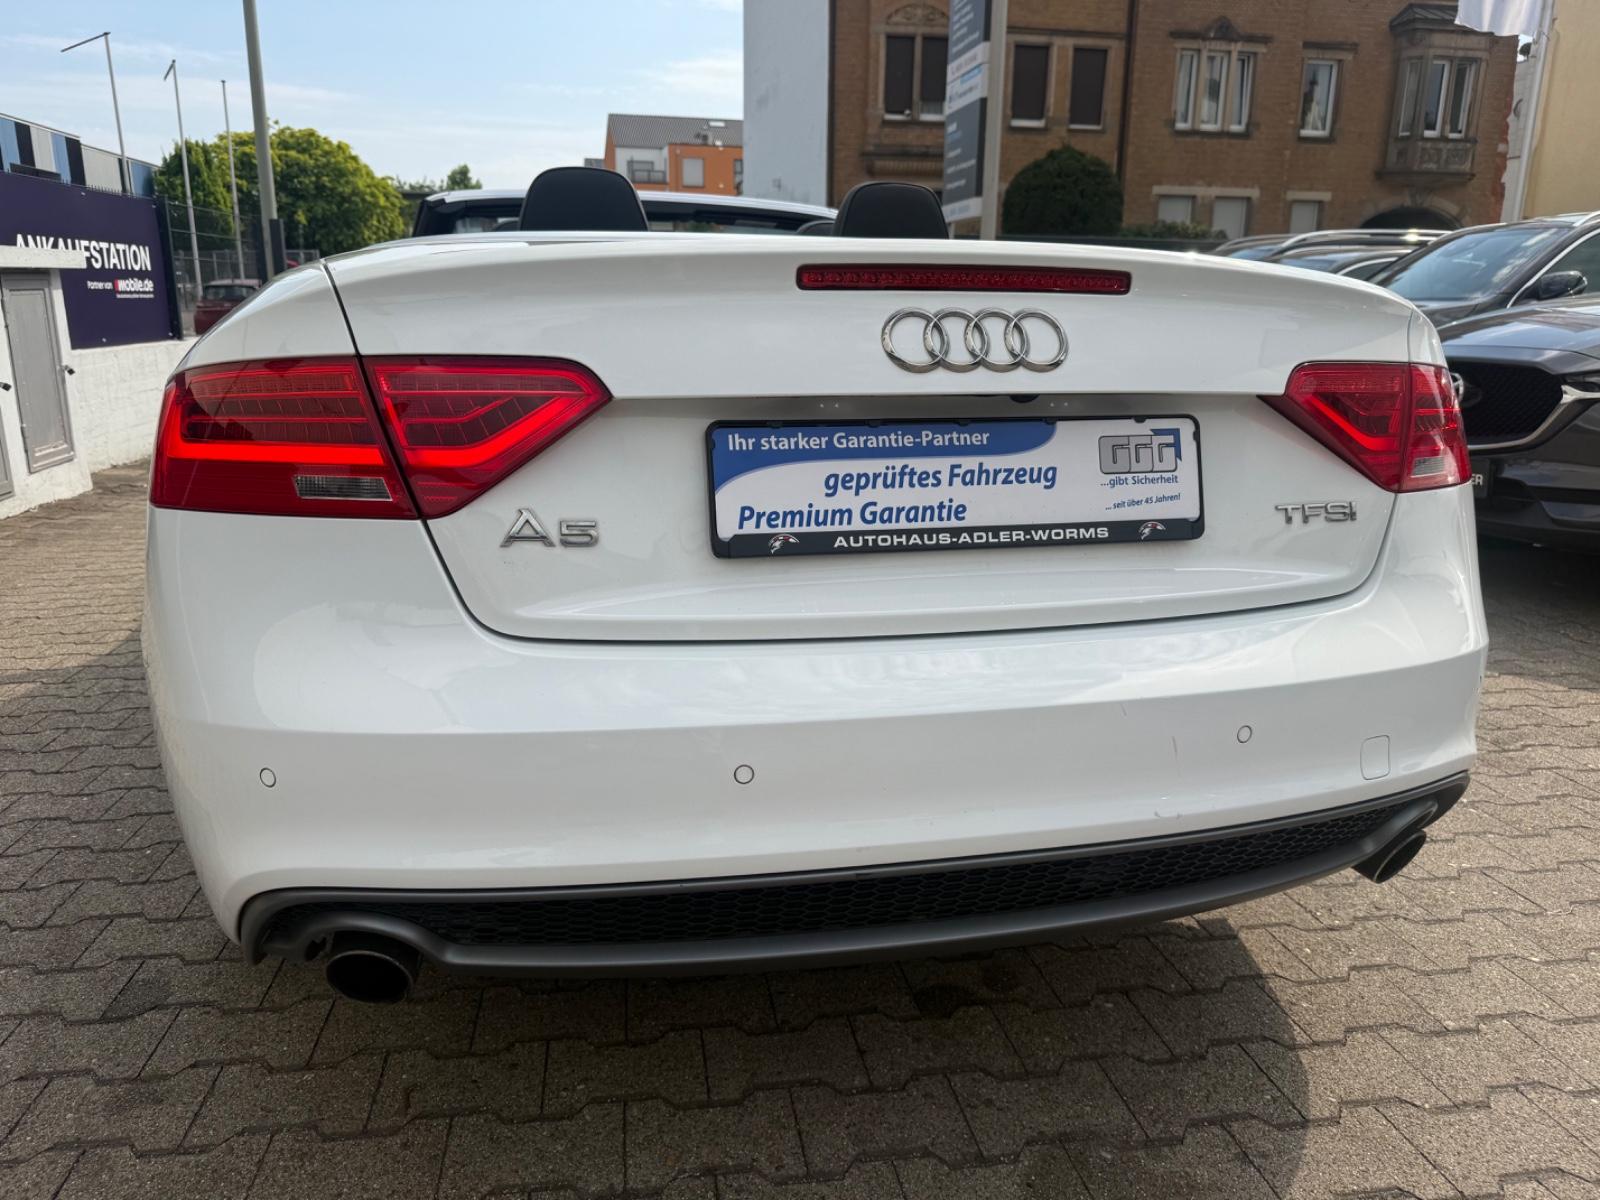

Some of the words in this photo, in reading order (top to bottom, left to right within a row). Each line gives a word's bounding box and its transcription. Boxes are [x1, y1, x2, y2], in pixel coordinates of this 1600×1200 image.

[728, 433, 755, 451] Ihr
[761, 432, 828, 450] starker
[833, 430, 990, 449] Garantie-Partner
[824, 464, 942, 497] geprüftes
[948, 462, 1057, 489] Fahrzeug
[1100, 475, 1129, 488] ...gibt
[1131, 474, 1178, 486] Sicherheit
[1113, 501, 1126, 510] seit
[1126, 497, 1143, 508] über
[1144, 496, 1154, 505] 45
[1154, 492, 1181, 504] Jahren!
[738, 503, 853, 530] Premium
[860, 498, 967, 525] Garantie
[1275, 501, 1357, 525] TFSI
[500, 507, 599, 548] A5
[834, 527, 1109, 547] AUTOHAUS-ADLER-WORMS
